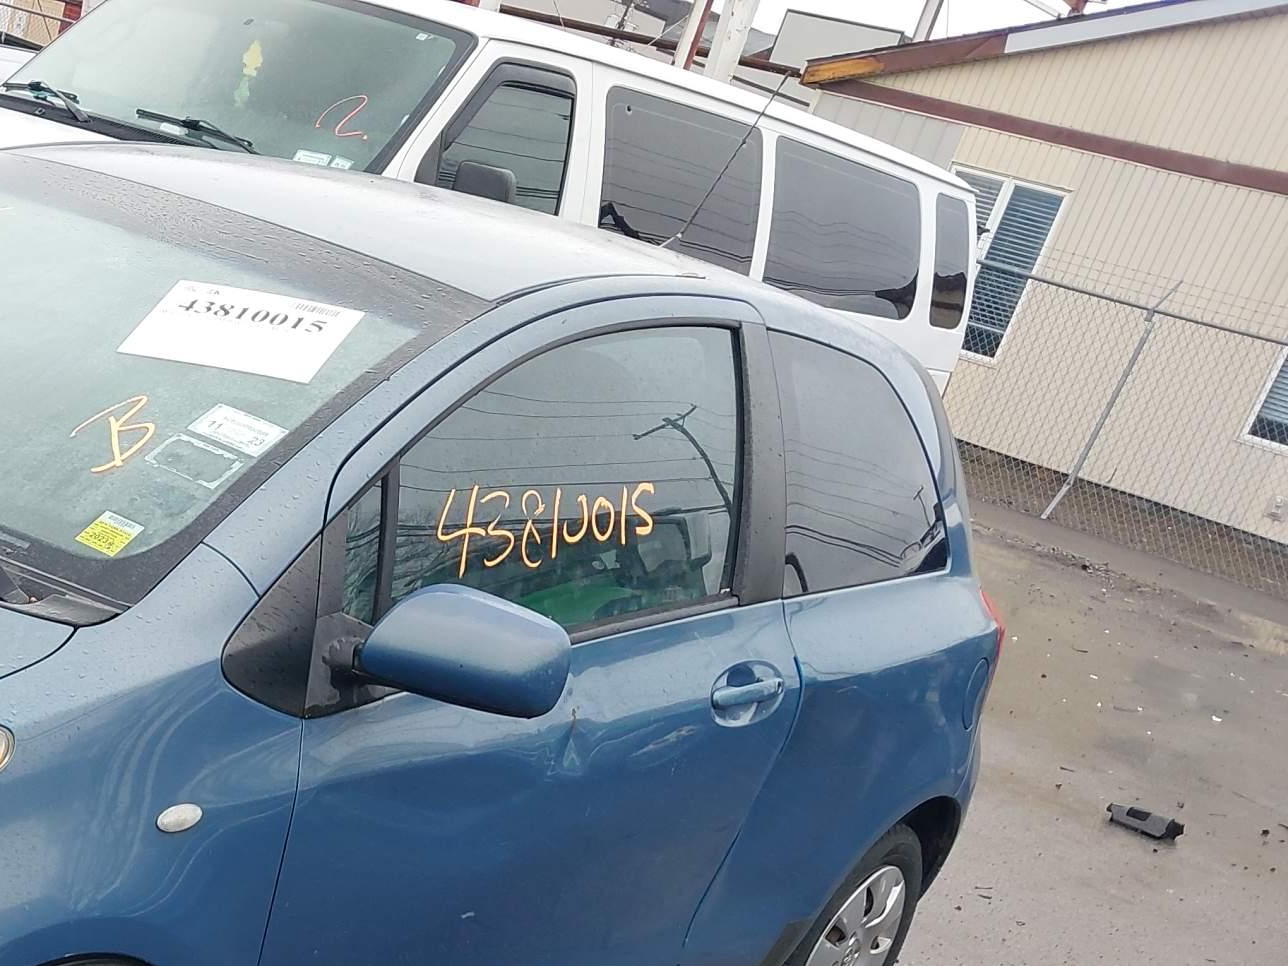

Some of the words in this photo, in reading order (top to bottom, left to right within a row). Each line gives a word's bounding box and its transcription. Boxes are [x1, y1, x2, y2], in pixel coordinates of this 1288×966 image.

[178, 298, 328, 333] 43810015
[69, 395, 156, 473] B
[437, 482, 654, 578] 43810015
